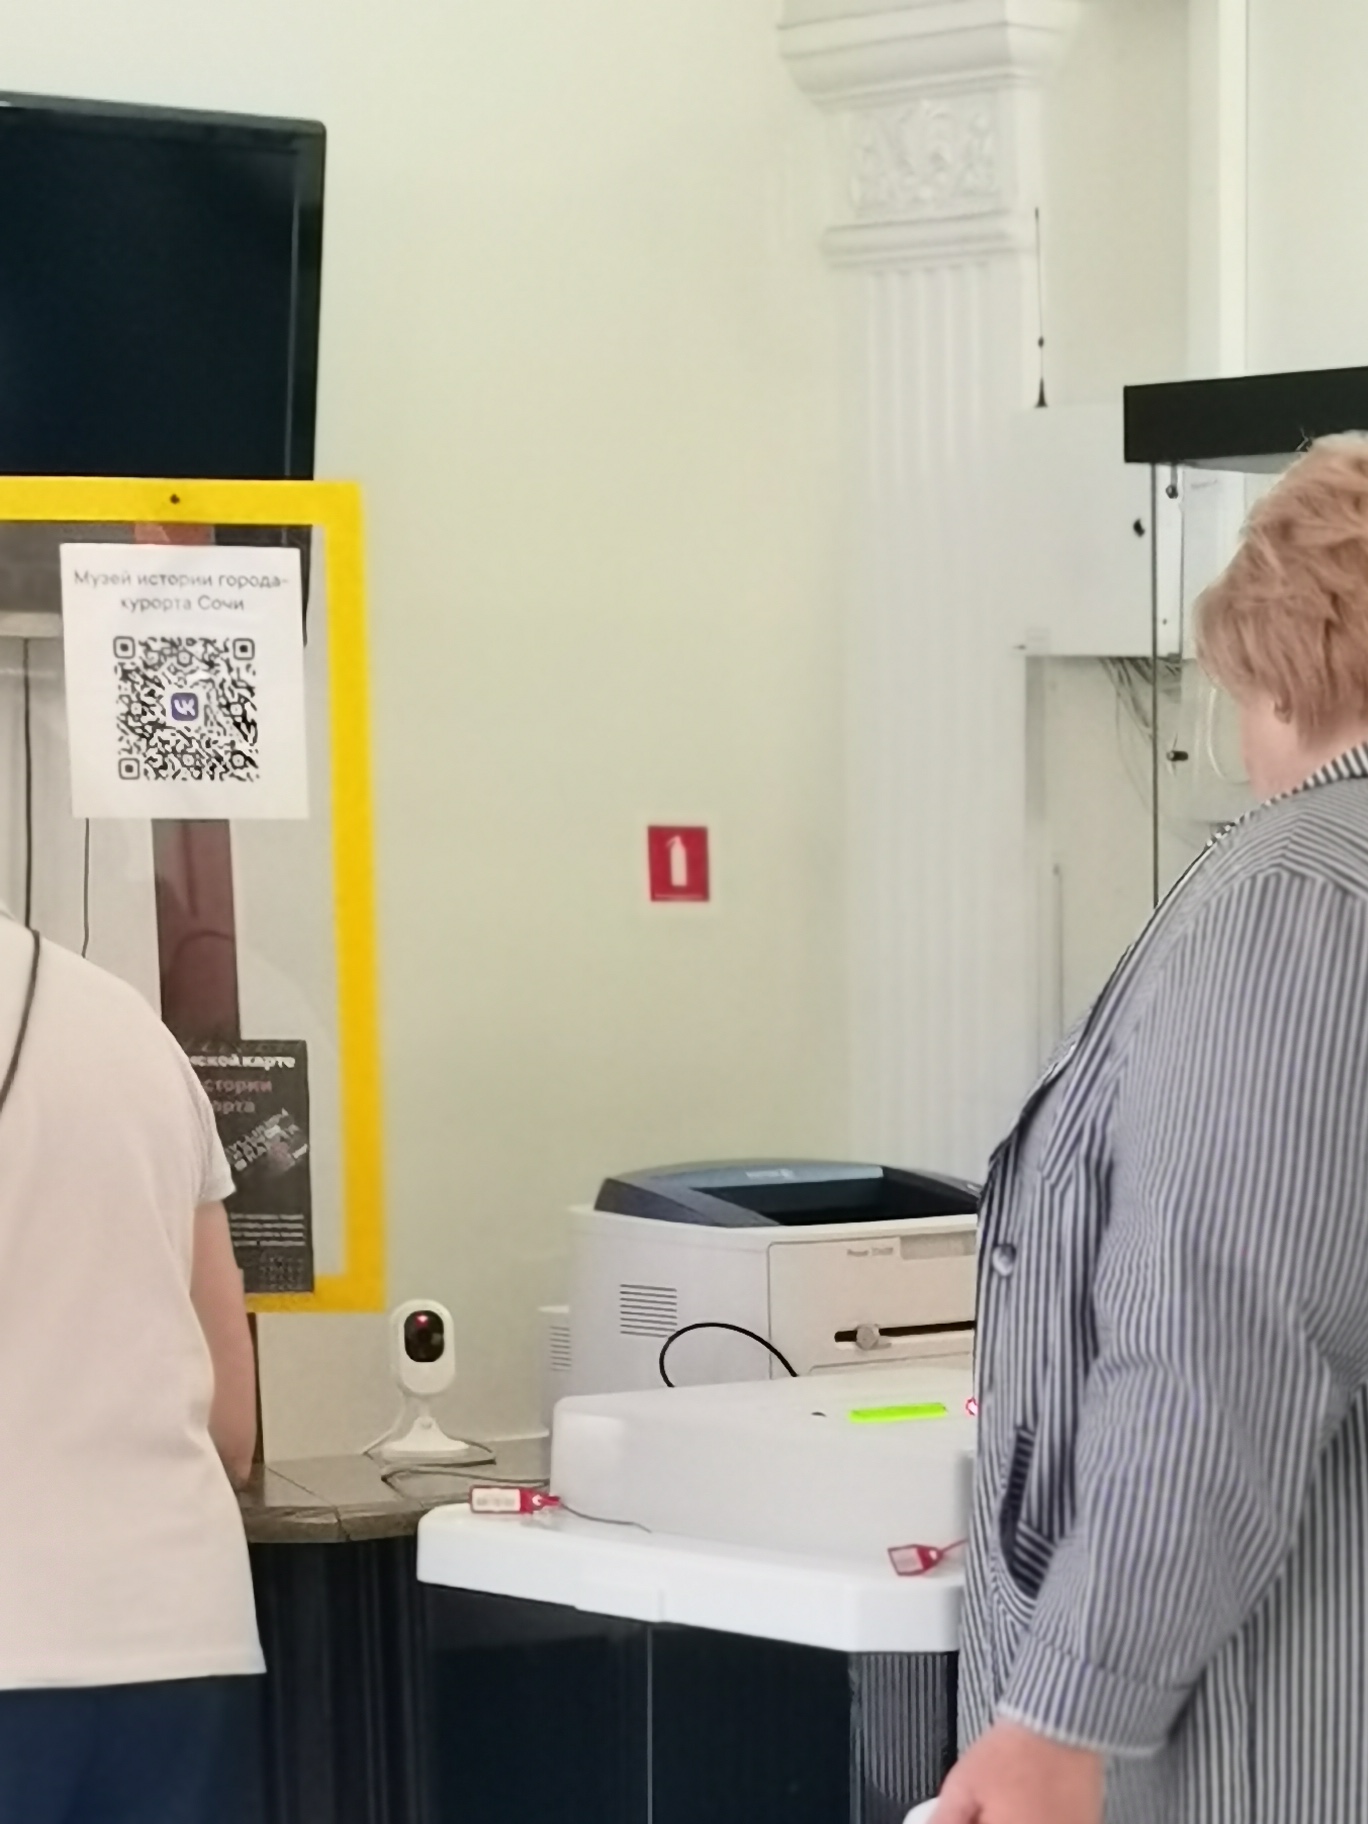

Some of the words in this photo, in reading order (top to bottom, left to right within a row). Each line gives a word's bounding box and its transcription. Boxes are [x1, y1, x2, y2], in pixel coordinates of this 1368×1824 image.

[74, 570, 131, 588] Музей
[138, 572, 213, 588] истории
[121, 598, 192, 613] курорта
[198, 594, 245, 612] Сочи
